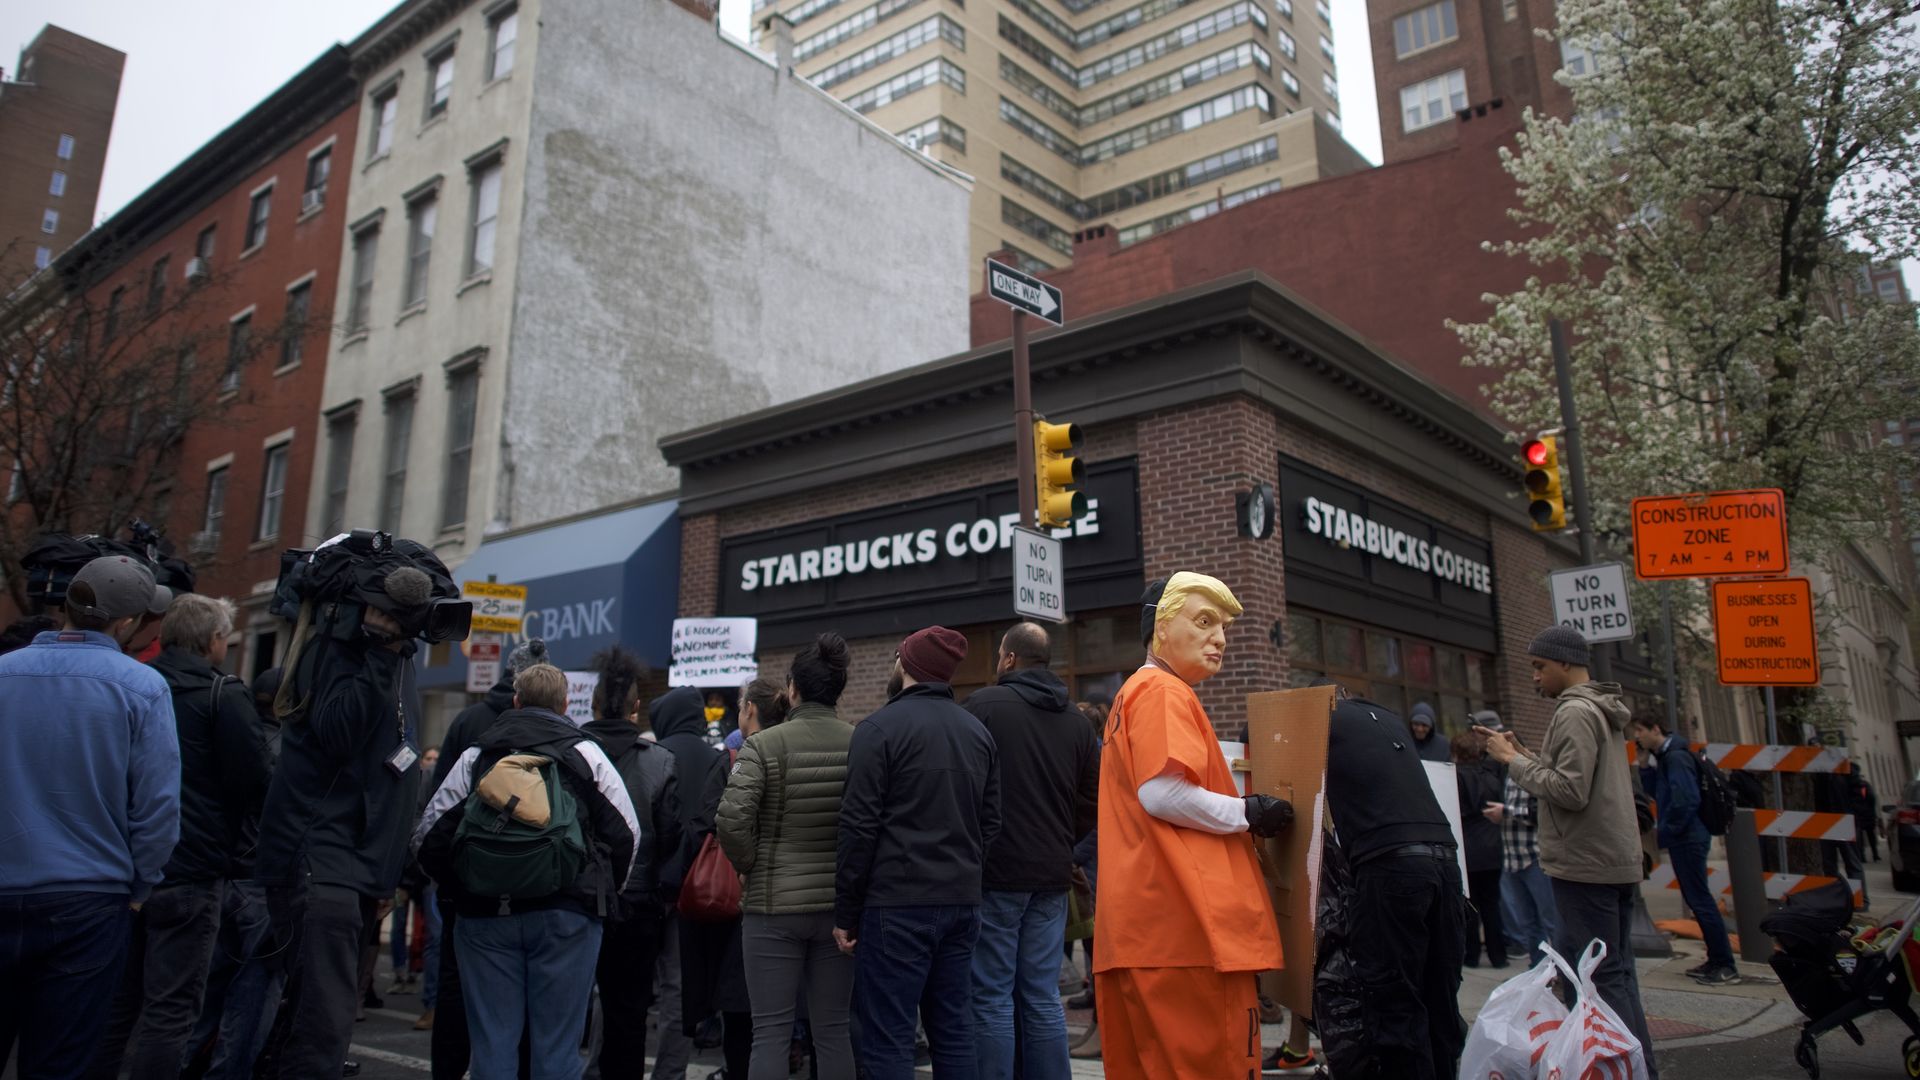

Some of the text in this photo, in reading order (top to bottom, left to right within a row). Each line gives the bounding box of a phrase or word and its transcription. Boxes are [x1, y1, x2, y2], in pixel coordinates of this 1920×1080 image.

[997, 275, 1041, 304] ONE WAY
[1640, 503, 1776, 525] CONSTRUCTION
[1306, 496, 1492, 594] STARBUCKS COFFEE
[1684, 529, 1732, 545] ZONE
[1029, 542, 1047, 560] NO
[1648, 554, 1657, 566] 7
[1670, 552, 1693, 565] AM
[1724, 551, 1733, 563] 4
[1745, 551, 1770, 563] PM
[741, 529, 937, 591] STARBUCKS
[1026, 565, 1052, 585] TURN
[1575, 575, 1600, 591] NO
[1020, 586, 1059, 610] ON RED
[1566, 593, 1616, 613] TURN
[1727, 593, 1797, 607] BUSINESSES
[481, 599, 501, 615] 25
[542, 597, 616, 642] BANK
[1591, 613, 1627, 630] RED
[1748, 615, 1779, 627] OPEN
[1744, 636, 1786, 649] DURING
[1724, 657, 1811, 670] CONSTRUCTION
